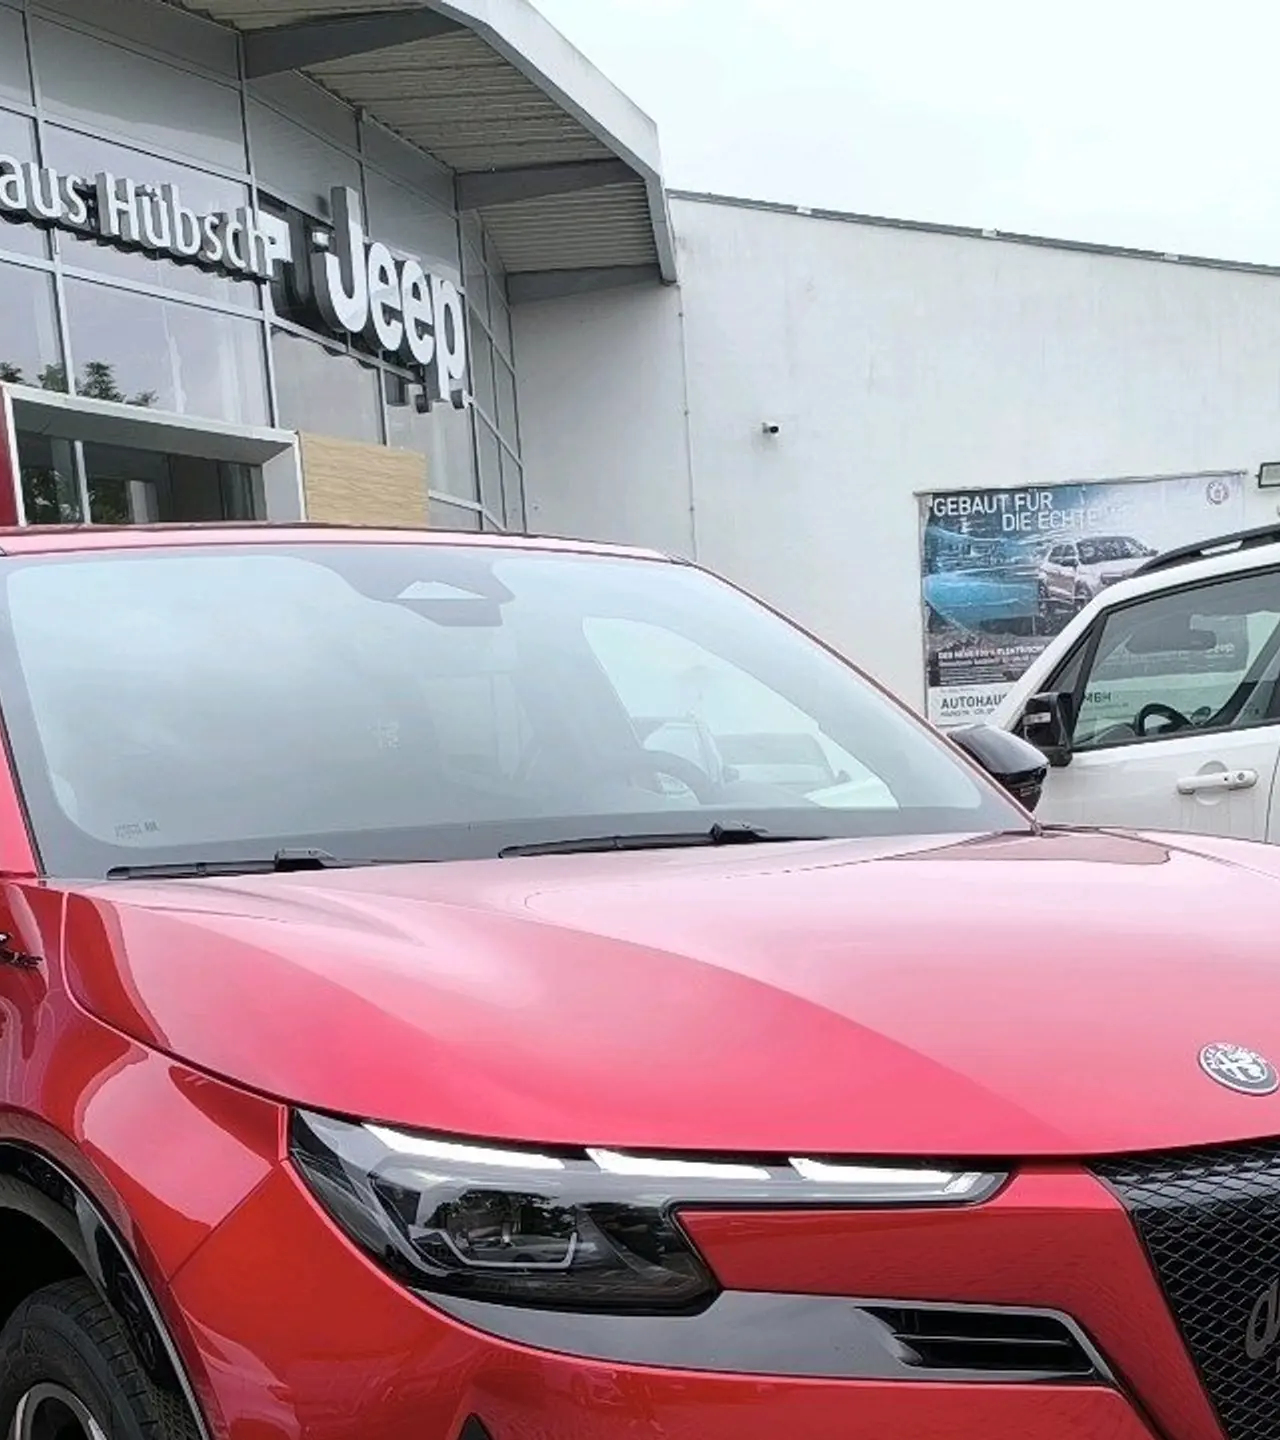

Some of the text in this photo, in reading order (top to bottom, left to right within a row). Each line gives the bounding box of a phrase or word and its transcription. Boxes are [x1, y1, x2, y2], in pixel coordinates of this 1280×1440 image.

[96, 171, 274, 278] Hübsch
[314, 187, 466, 401] Jeep
[933, 489, 1053, 517] GEBAUT FÜR
[1002, 513, 1032, 532] DIE
[1038, 507, 1098, 529] ECHTE
